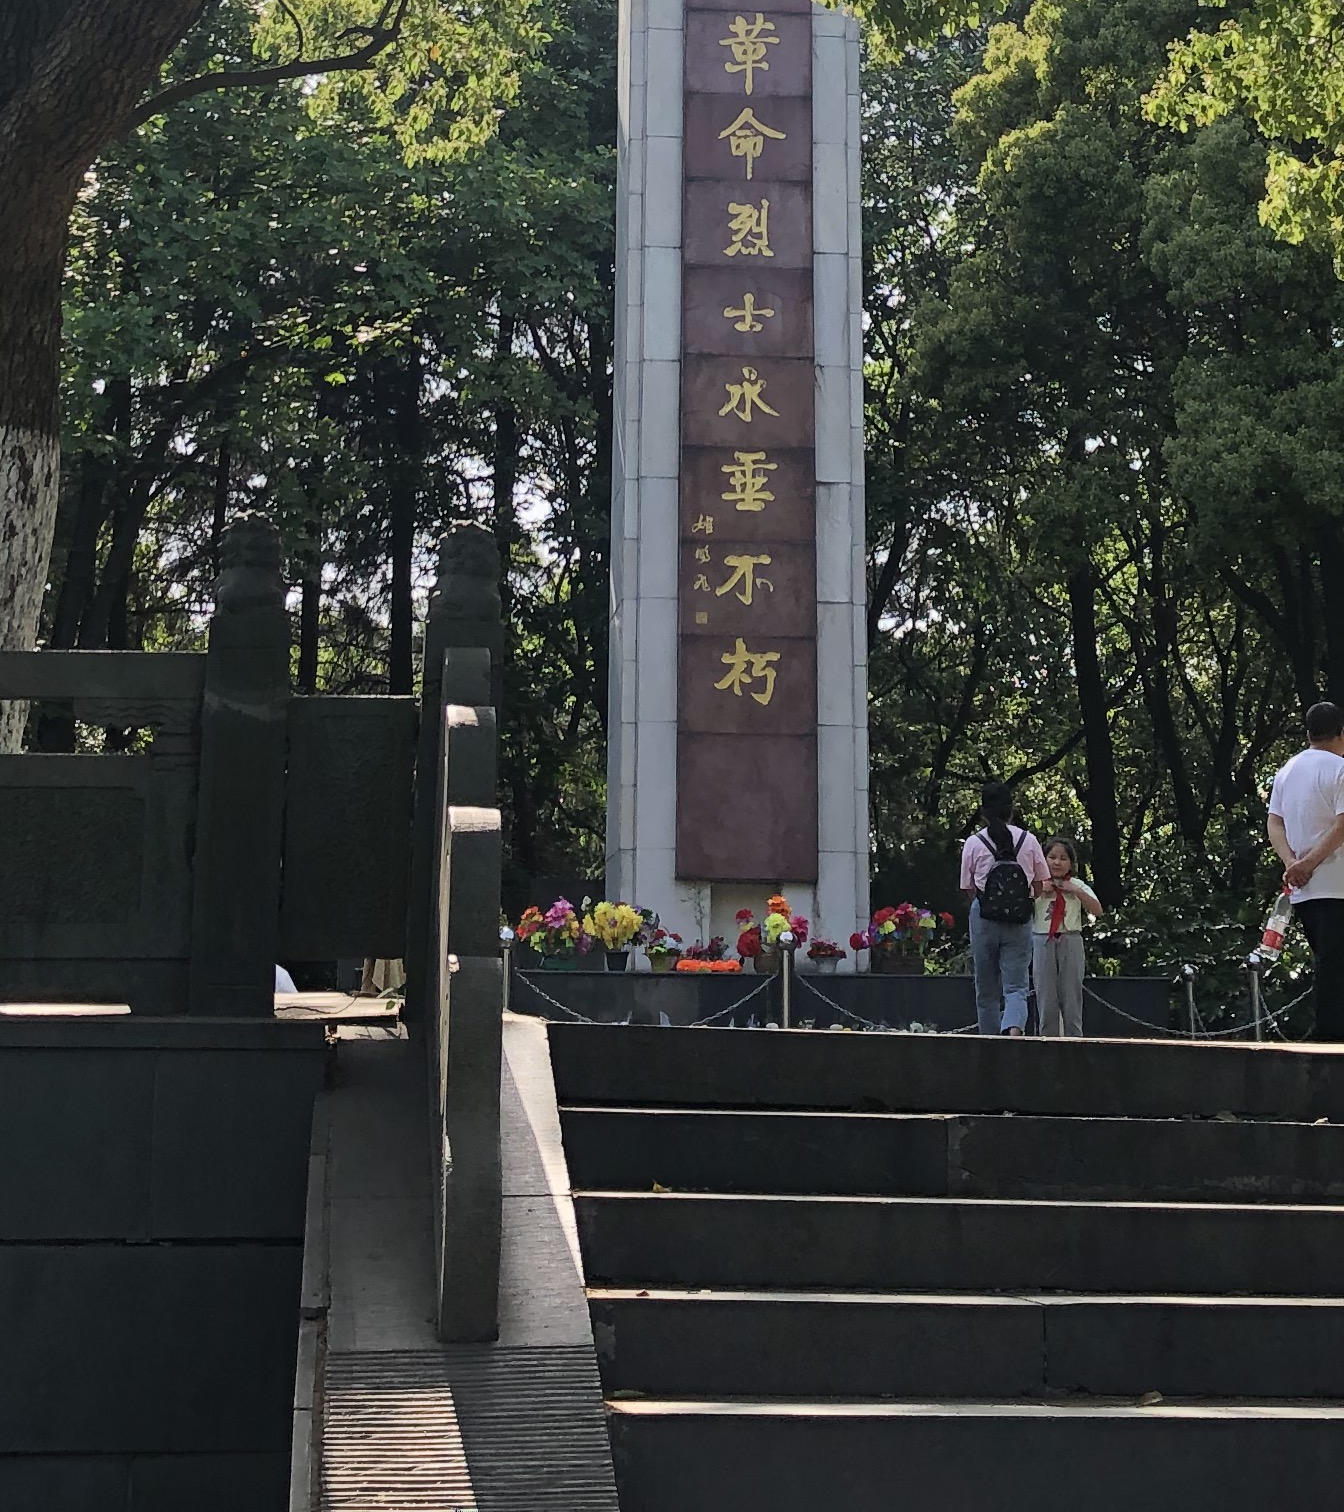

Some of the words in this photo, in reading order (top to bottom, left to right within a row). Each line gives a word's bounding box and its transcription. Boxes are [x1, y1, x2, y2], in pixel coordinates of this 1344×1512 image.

[713, 12, 787, 706] 革命烈士永垂不朽
